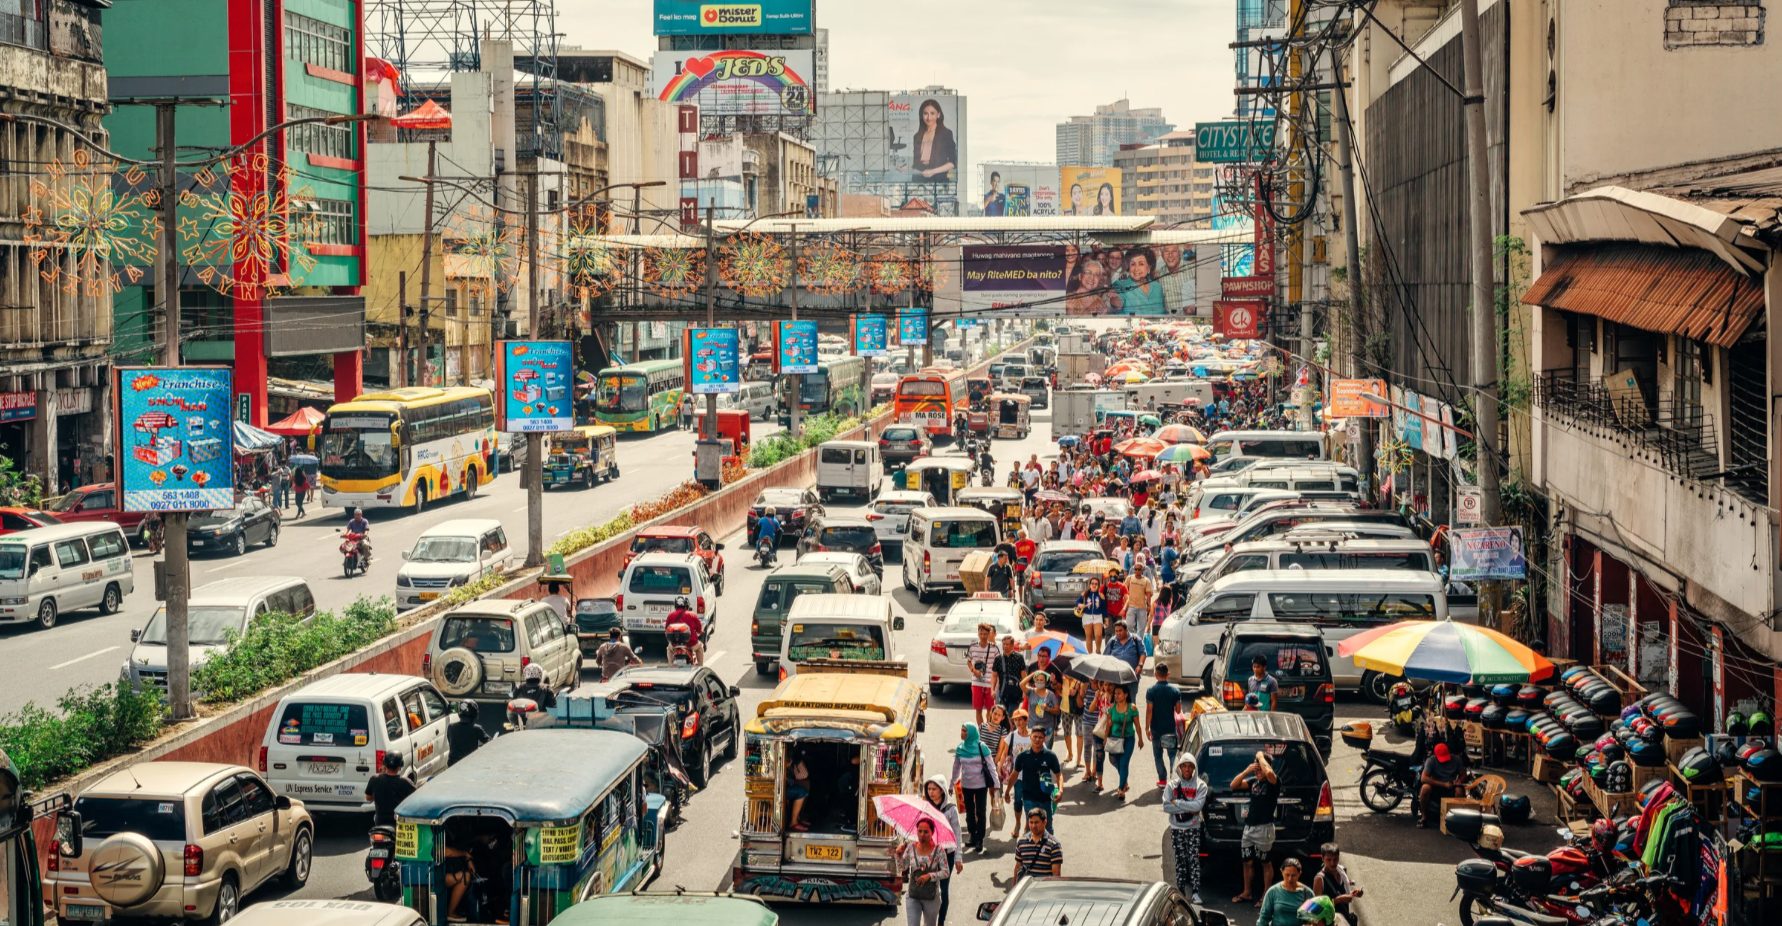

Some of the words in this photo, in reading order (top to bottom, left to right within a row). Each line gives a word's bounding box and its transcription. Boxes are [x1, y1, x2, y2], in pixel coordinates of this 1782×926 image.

[674, 61, 682, 75] I
[716, 56, 786, 80] JED'S
[786, 92, 804, 103] 24
[888, 101, 911, 111] ANG
[1200, 150, 1220, 158] HOTEL
[967, 271, 986, 281] May
[988, 270, 1025, 279] RiteMED
[1027, 270, 1038, 278] ba
[1040, 269, 1062, 278] nito?
[1223, 281, 1273, 291] PAWNSHOP
[162, 379, 217, 389] Franchise
[5, 394, 17, 409] STOP
[163, 491, 177, 500] 563
[181, 491, 199, 500] 1408
[294, 784, 313, 794] Express
[315, 784, 332, 793] Service
[810, 847, 822, 856] TWZ
[827, 848, 839, 857] 122
